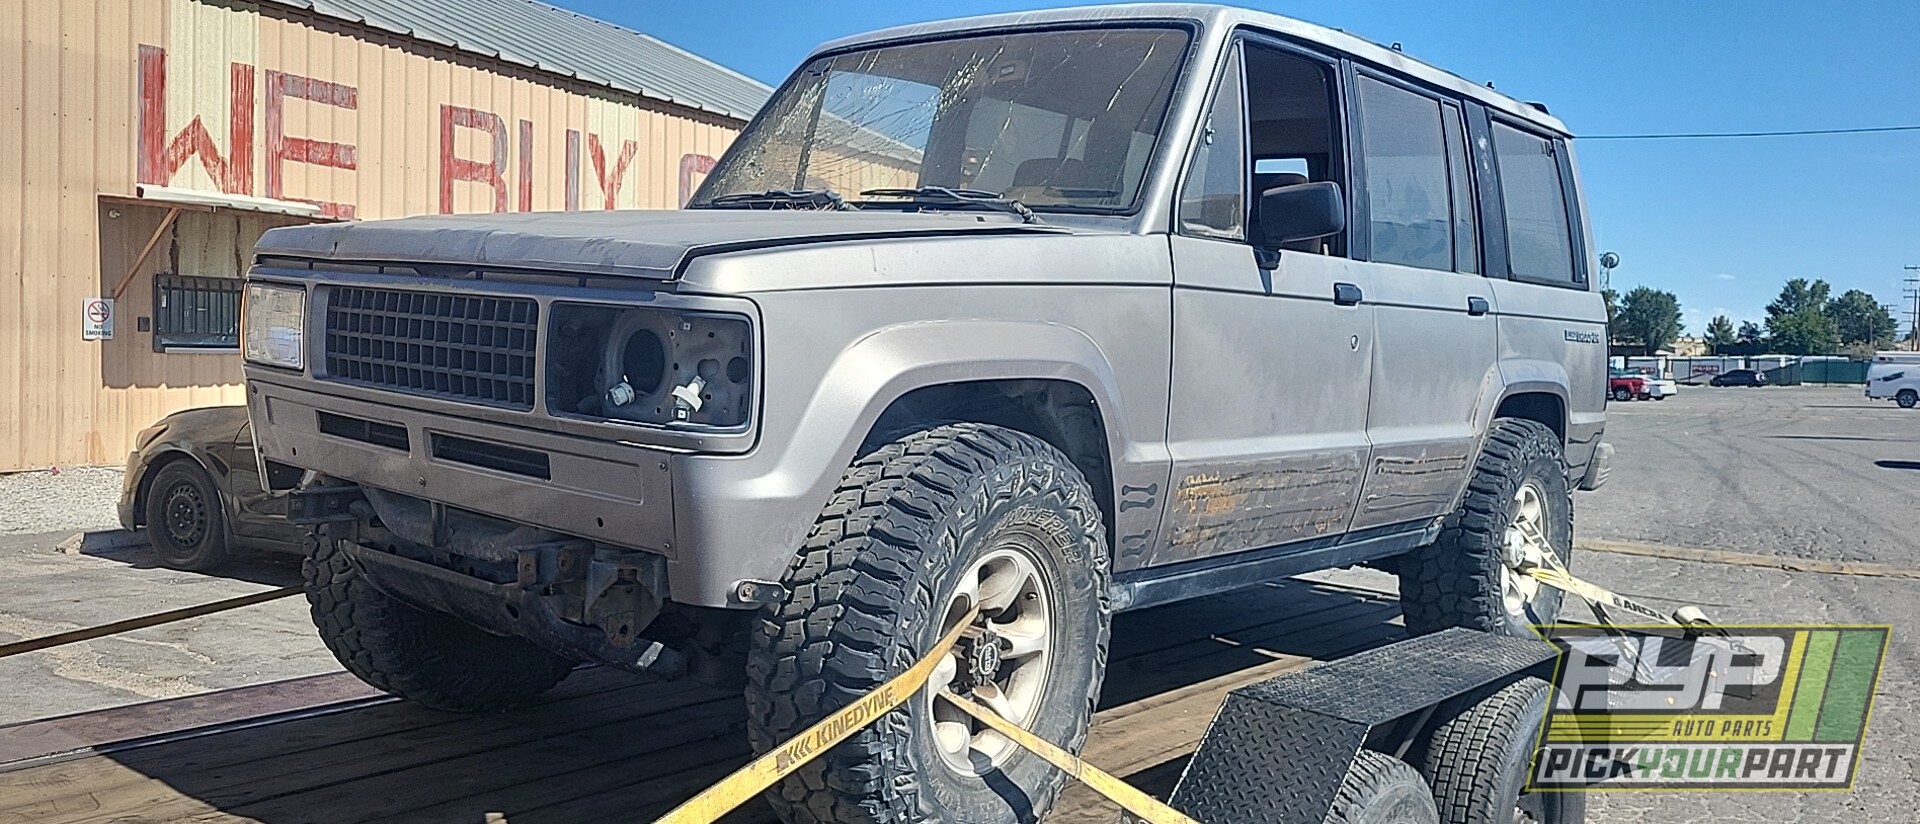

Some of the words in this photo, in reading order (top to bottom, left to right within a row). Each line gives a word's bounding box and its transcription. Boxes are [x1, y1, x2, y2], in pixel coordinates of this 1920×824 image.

[136, 43, 358, 219] WE
[440, 103, 638, 214] BUY
[815, 686, 894, 749] KINEDYNE
